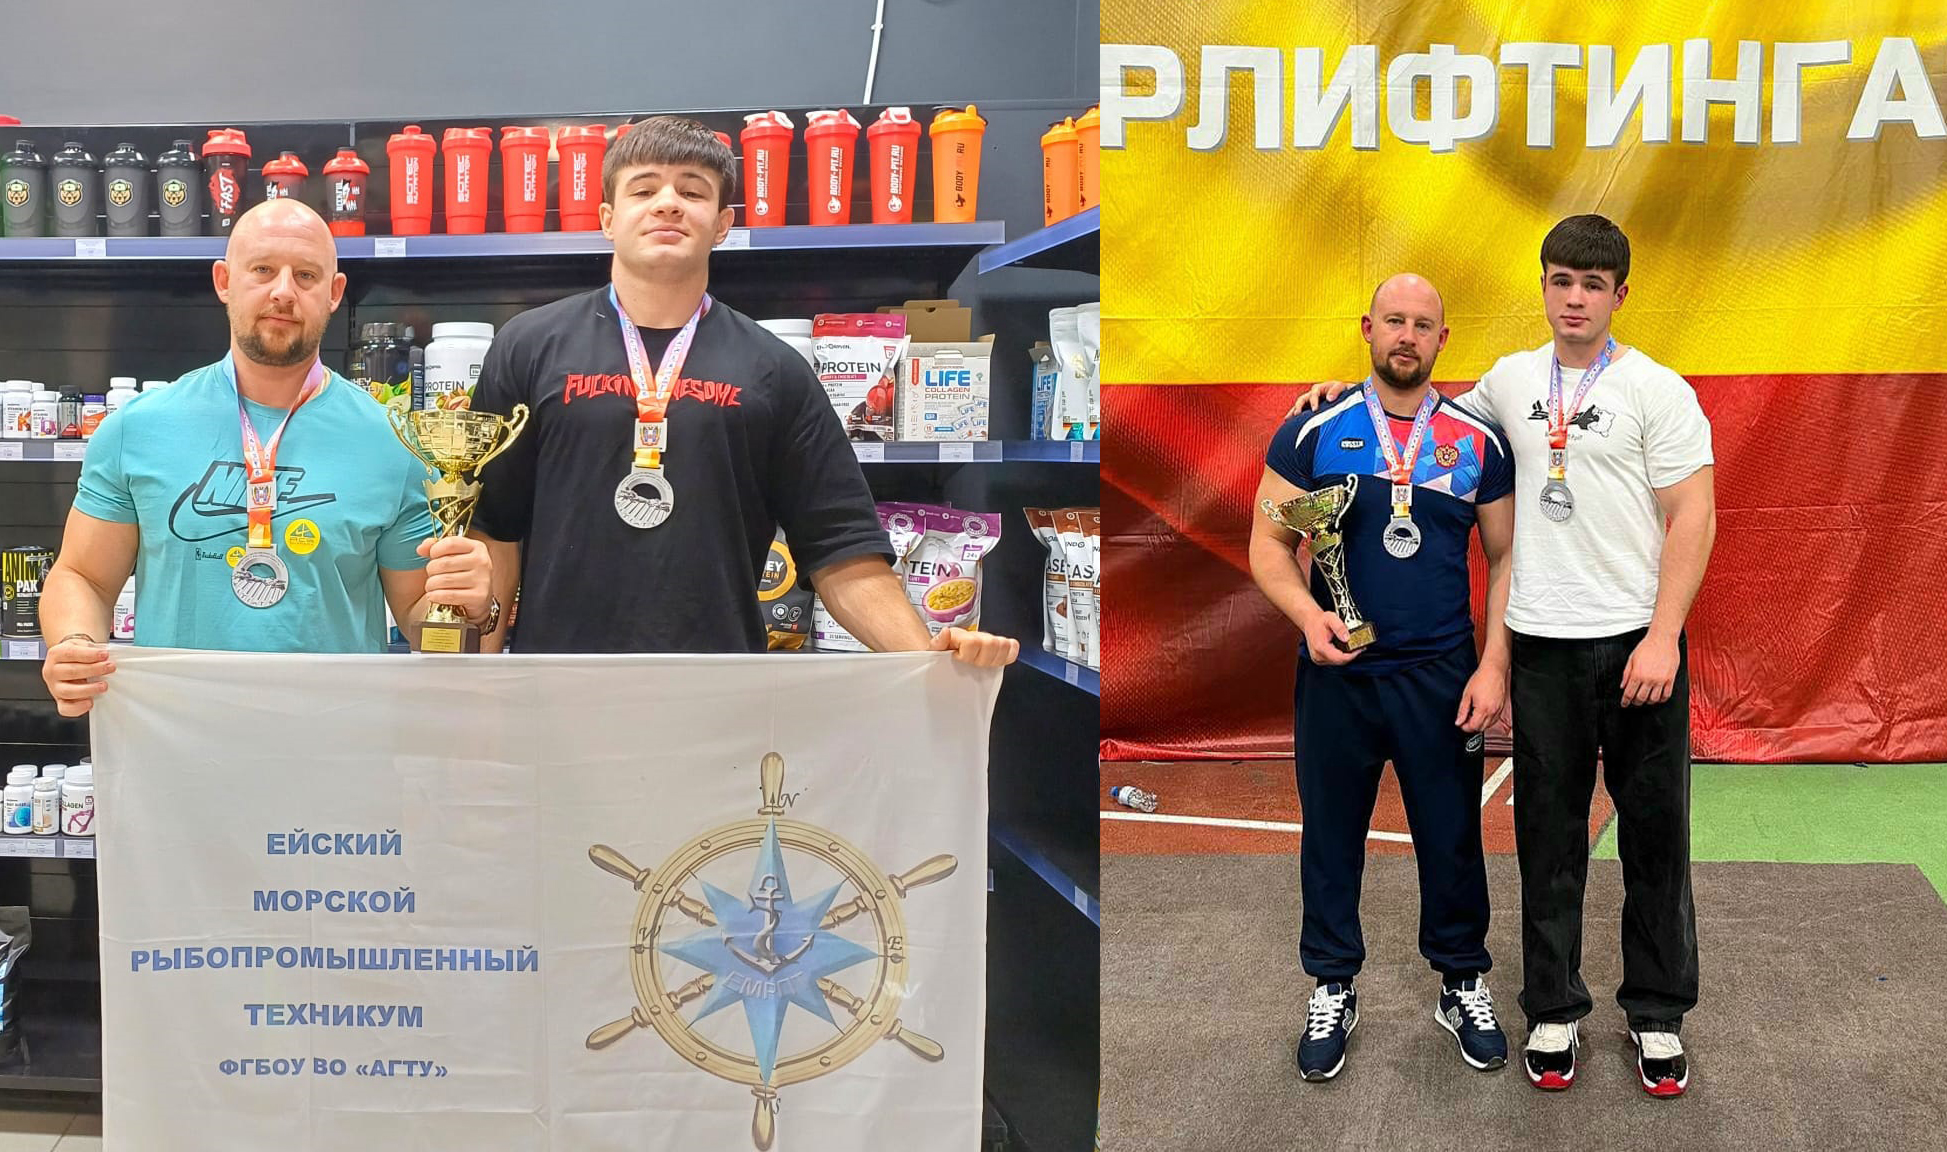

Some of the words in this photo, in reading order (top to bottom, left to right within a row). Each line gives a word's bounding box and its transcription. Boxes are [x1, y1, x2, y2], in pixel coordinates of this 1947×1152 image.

[821, 361, 882, 374] PROTEIN
[925, 370, 971, 387] LIFE
[1037, 375, 1051, 391] LIFE
[193, 460, 305, 508] NIE
[16, 580, 38, 593] PAK
[781, 792, 800, 808] N
[266, 828, 402, 856] ЕЙСКИЙ
[253, 886, 416, 913] МОРСКОЙ
[887, 935, 903, 951] E
[131, 944, 539, 972] РЫБОПРОМЫШЛЕННЫЙ
[243, 1003, 423, 1028] ТЕХНИКУМ
[218, 1057, 306, 1077] ФГБОУ
[313, 1057, 347, 1076] ВО
[355, 1059, 449, 1078] «АГТУ»
